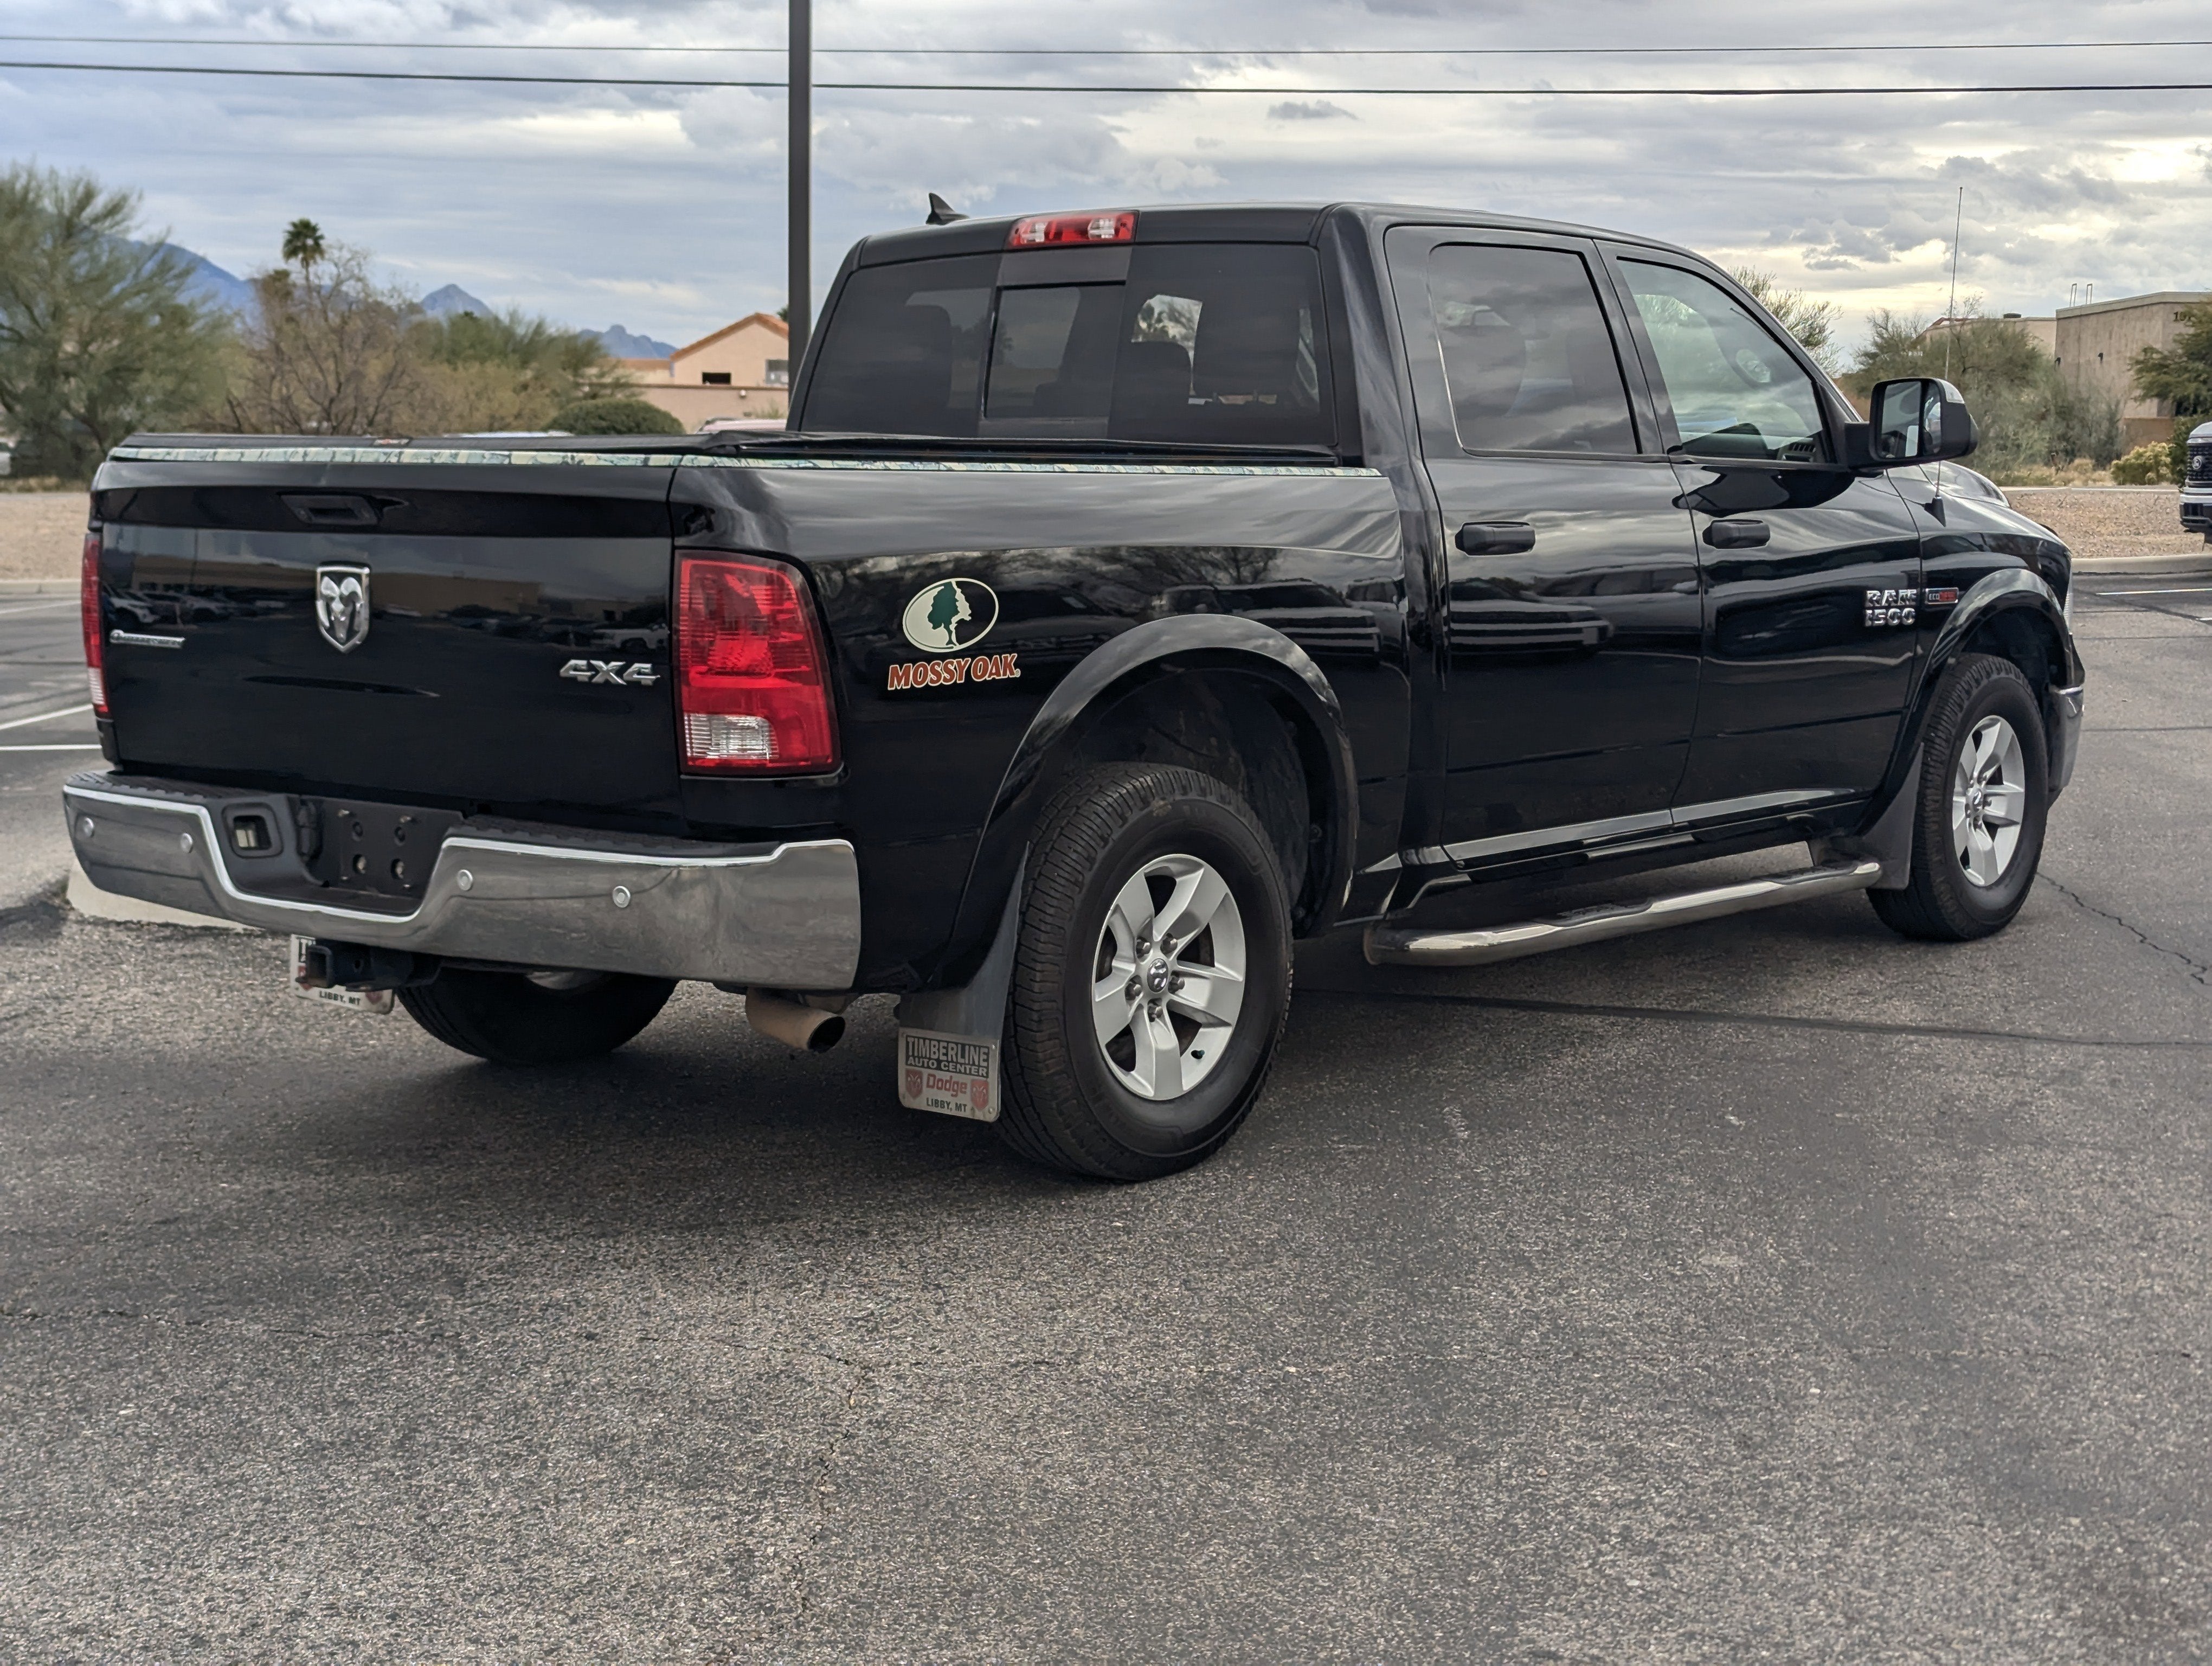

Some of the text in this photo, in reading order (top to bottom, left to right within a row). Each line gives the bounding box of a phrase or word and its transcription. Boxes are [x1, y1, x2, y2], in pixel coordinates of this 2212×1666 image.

[1865, 589, 1917, 606] RAM
[1865, 607, 1916, 627] 1500
[888, 653, 1018, 690] MOSSY OAK
[349, 996, 361, 1005] MT
[907, 1036, 988, 1067] TIMBERLINE
[907, 1056, 987, 1077] AUTO CENTER
[926, 1073, 968, 1097] Dodge
[926, 1097, 967, 1112] LIBBY, MT
